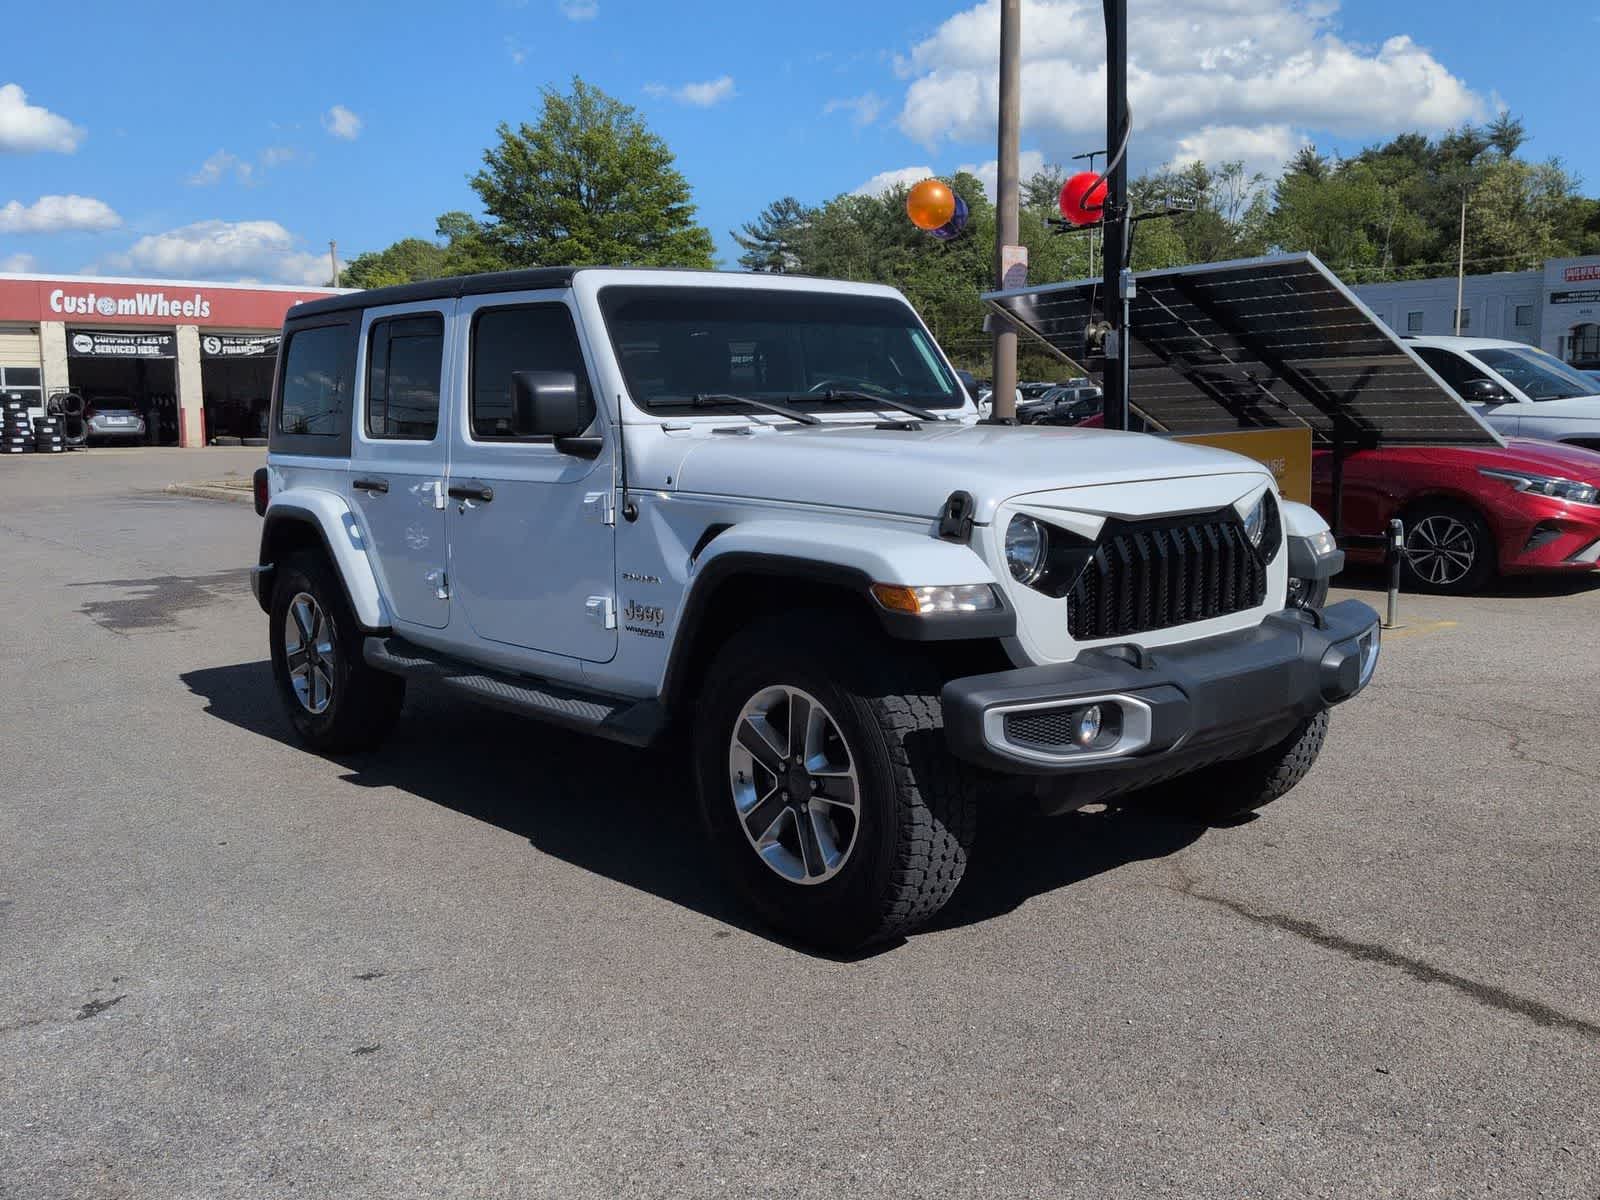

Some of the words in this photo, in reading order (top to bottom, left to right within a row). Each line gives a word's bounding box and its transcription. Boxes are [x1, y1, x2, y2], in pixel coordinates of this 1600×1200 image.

[94, 345, 136, 354] SERVICED
[137, 346, 161, 354] HERE
[623, 600, 664, 627] Jeep
